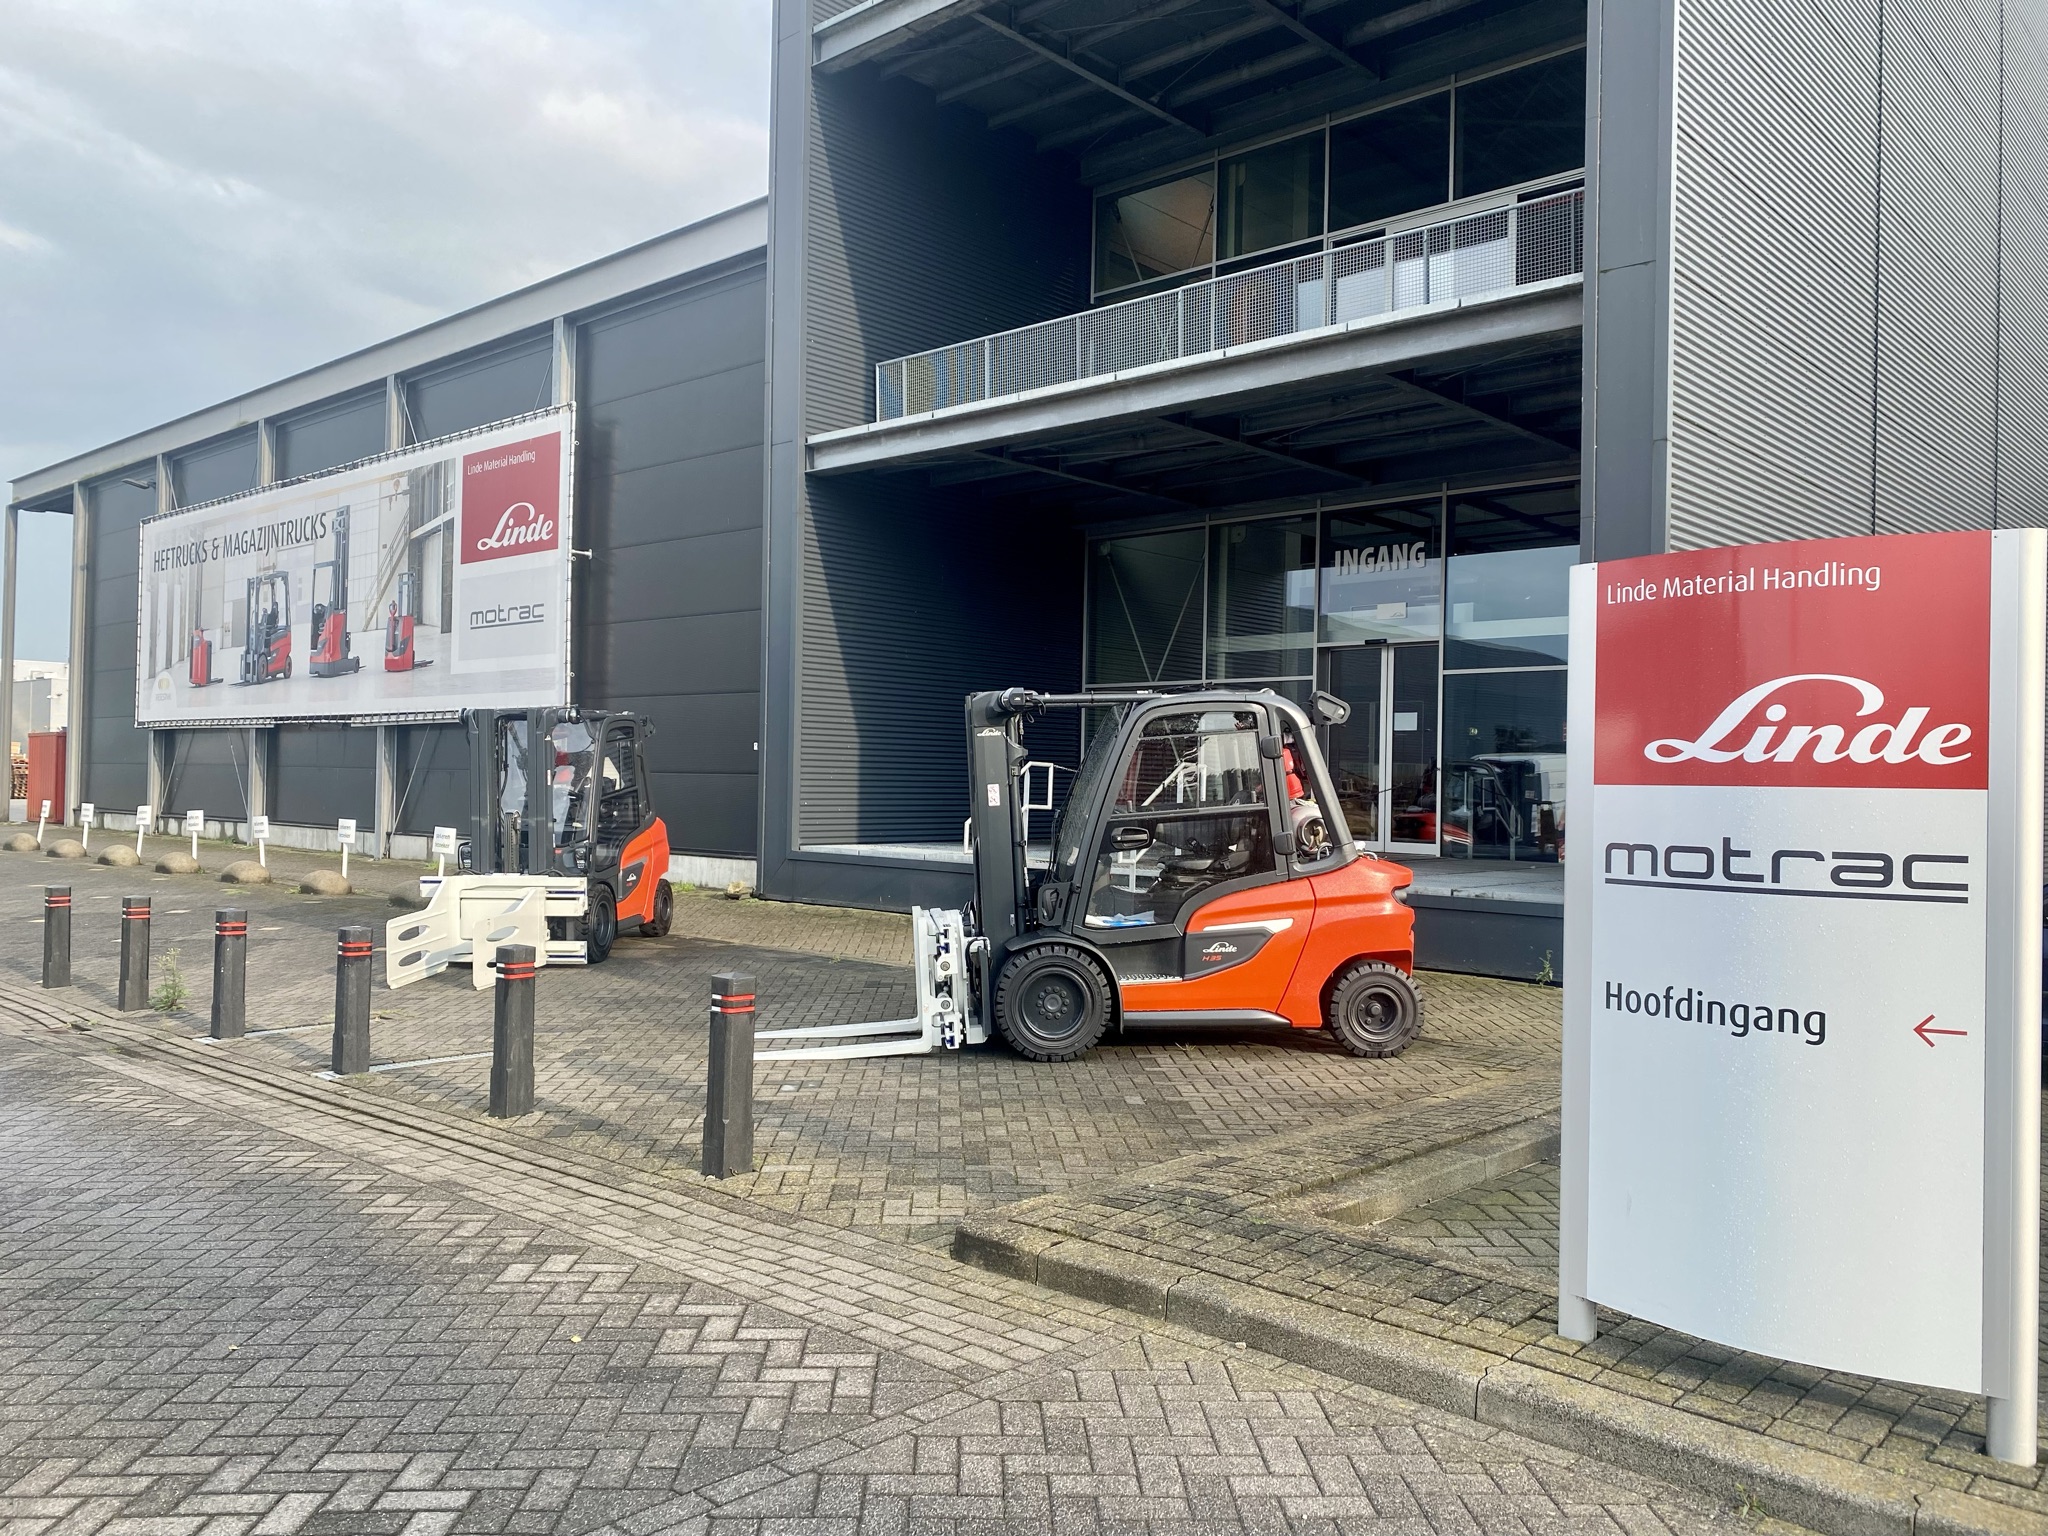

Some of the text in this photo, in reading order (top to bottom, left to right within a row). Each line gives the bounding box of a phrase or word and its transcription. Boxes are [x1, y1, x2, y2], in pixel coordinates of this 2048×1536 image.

[467, 450, 536, 476] Linde Material Handling
[153, 512, 327, 573] HEFTRUCKS & MAGAZIJNTRUCKS
[477, 502, 554, 551] Linde
[1334, 541, 1426, 576] INGANG
[1607, 561, 1881, 604] Linde Material Handling
[470, 603, 545, 627] motrac
[1643, 673, 1973, 765] Linde
[1605, 836, 1969, 893] motrac
[1202, 941, 1238, 953] Linde
[1604, 980, 1827, 1046] Hoofdingang
